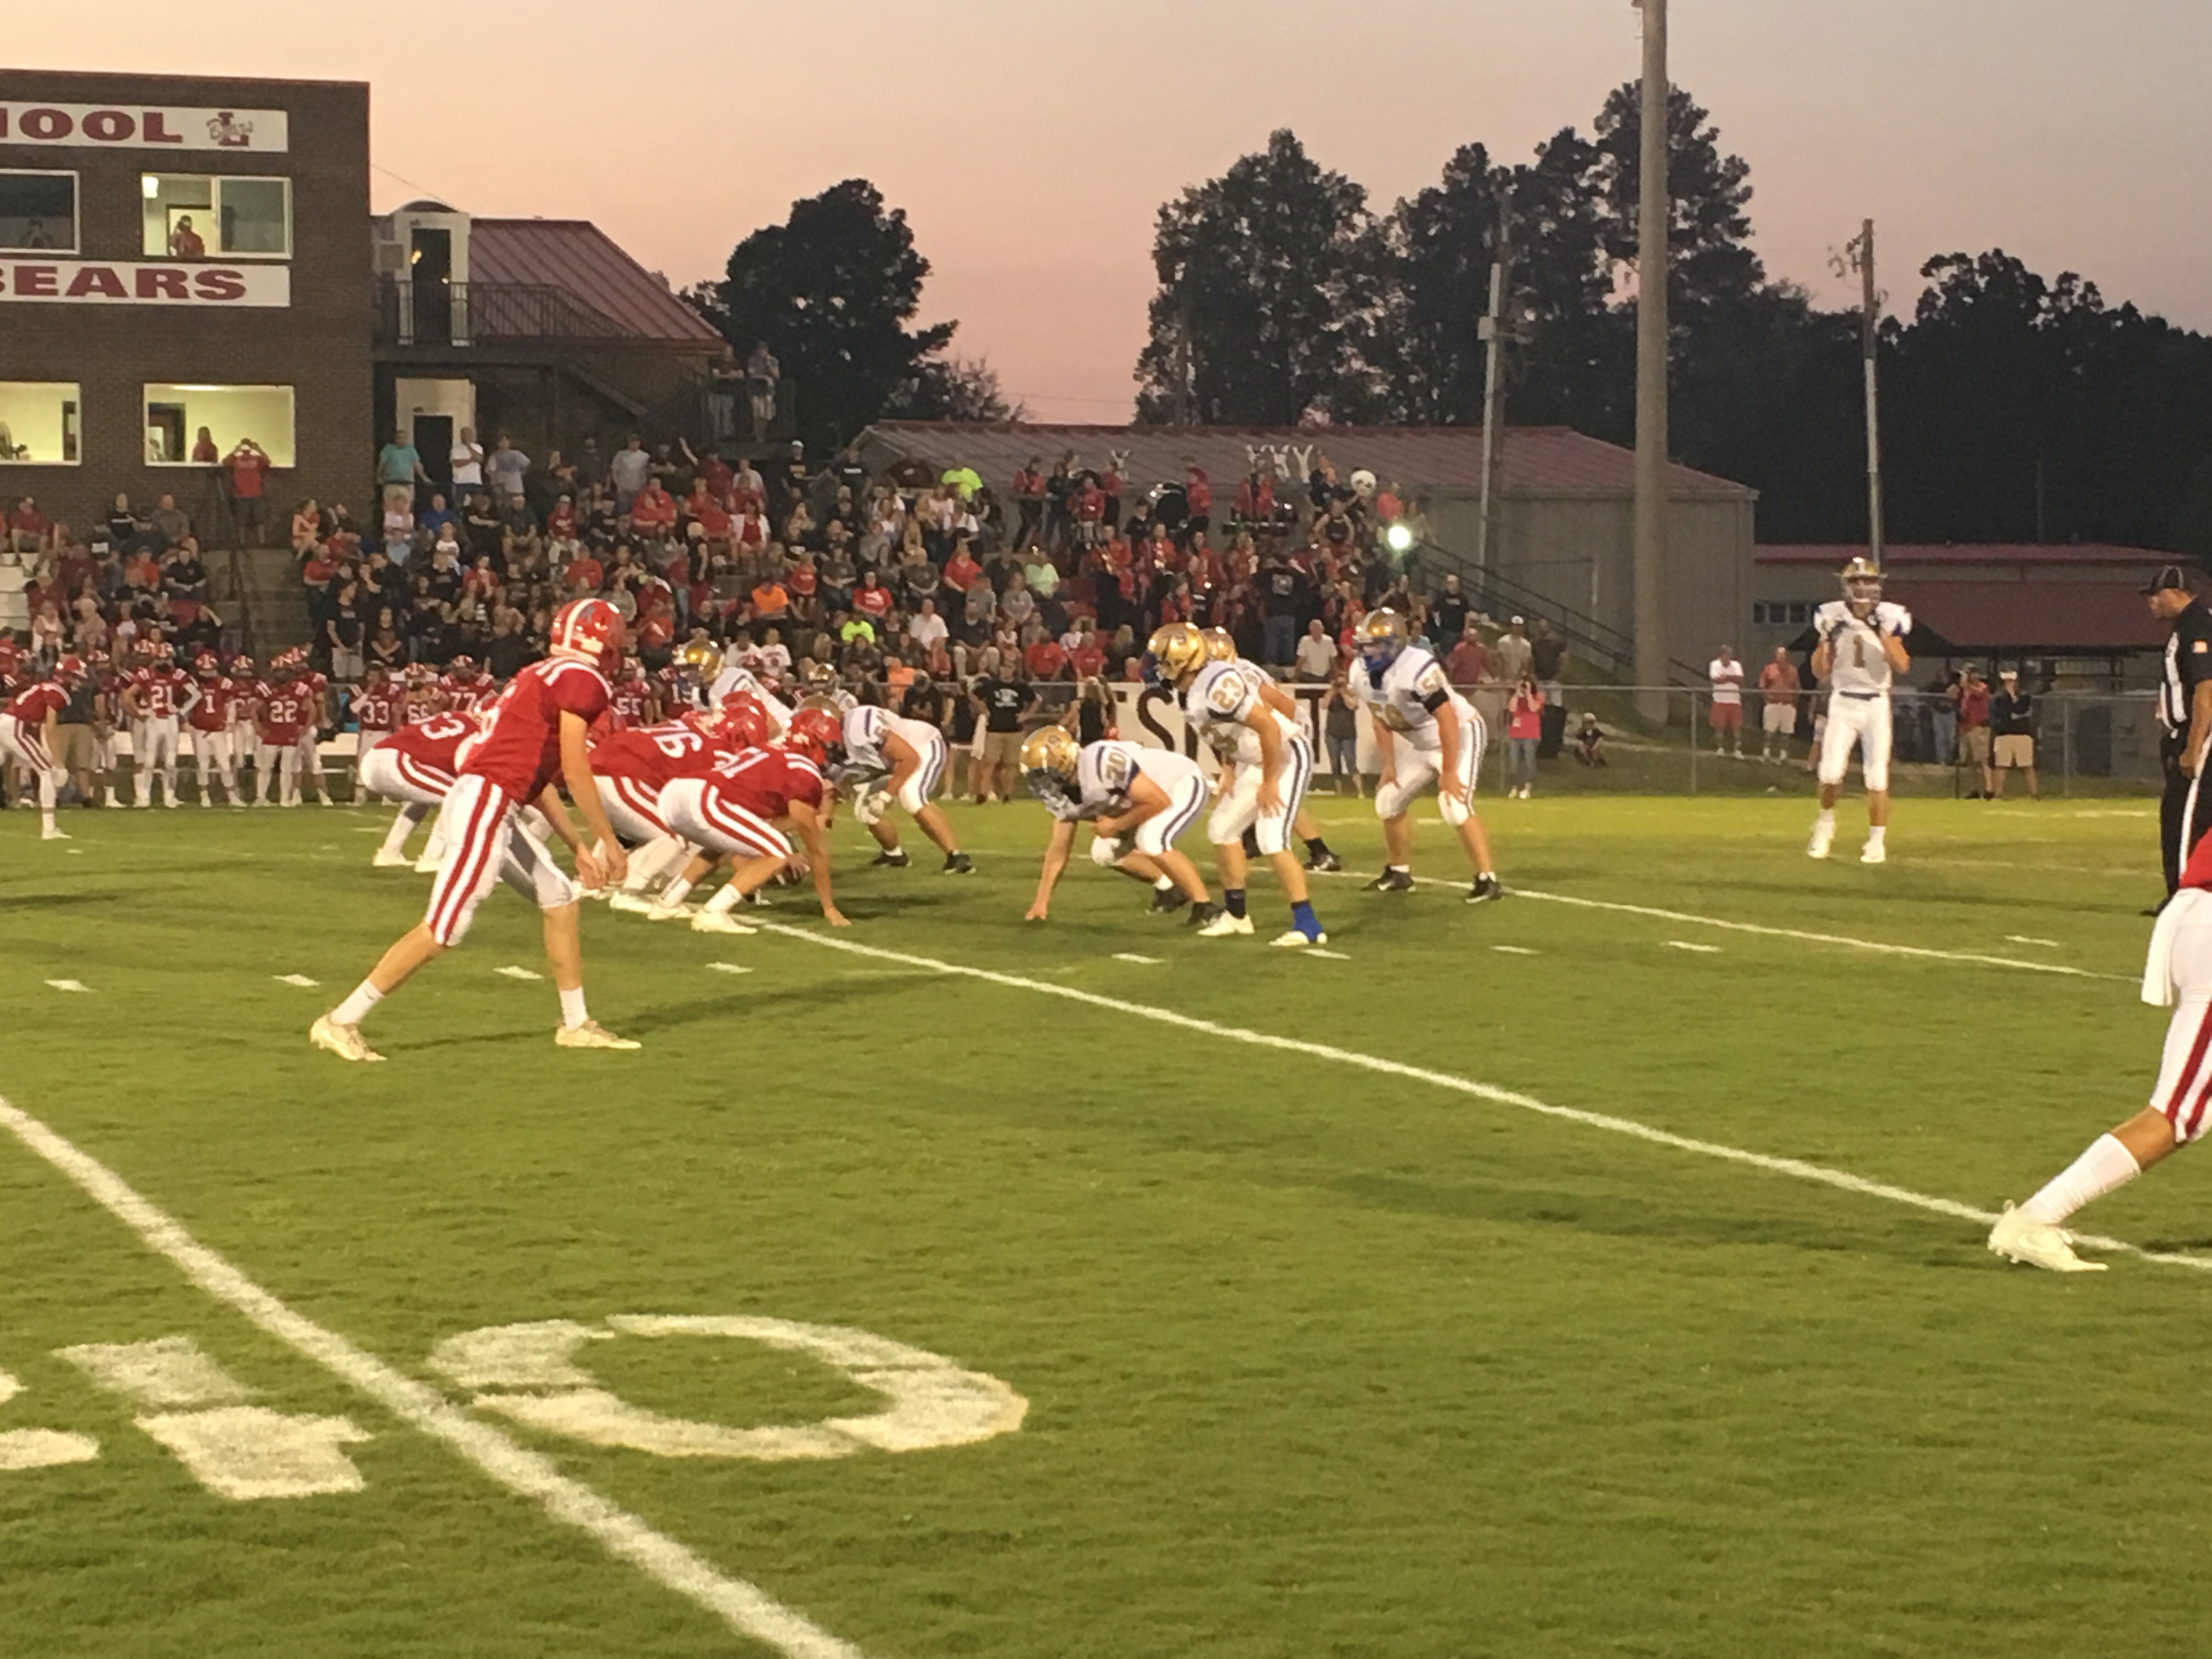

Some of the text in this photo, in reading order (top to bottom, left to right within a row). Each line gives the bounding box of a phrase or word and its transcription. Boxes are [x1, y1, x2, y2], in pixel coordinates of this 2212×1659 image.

[0, 108, 183, 143] OOL
[0, 266, 247, 301] EARS
[1853, 633, 1866, 668] 1
[151, 685, 173, 709] 21
[205, 695, 216, 714] 1
[1212, 676, 1242, 710] 23
[269, 700, 298, 723] 22
[362, 701, 390, 725] 33
